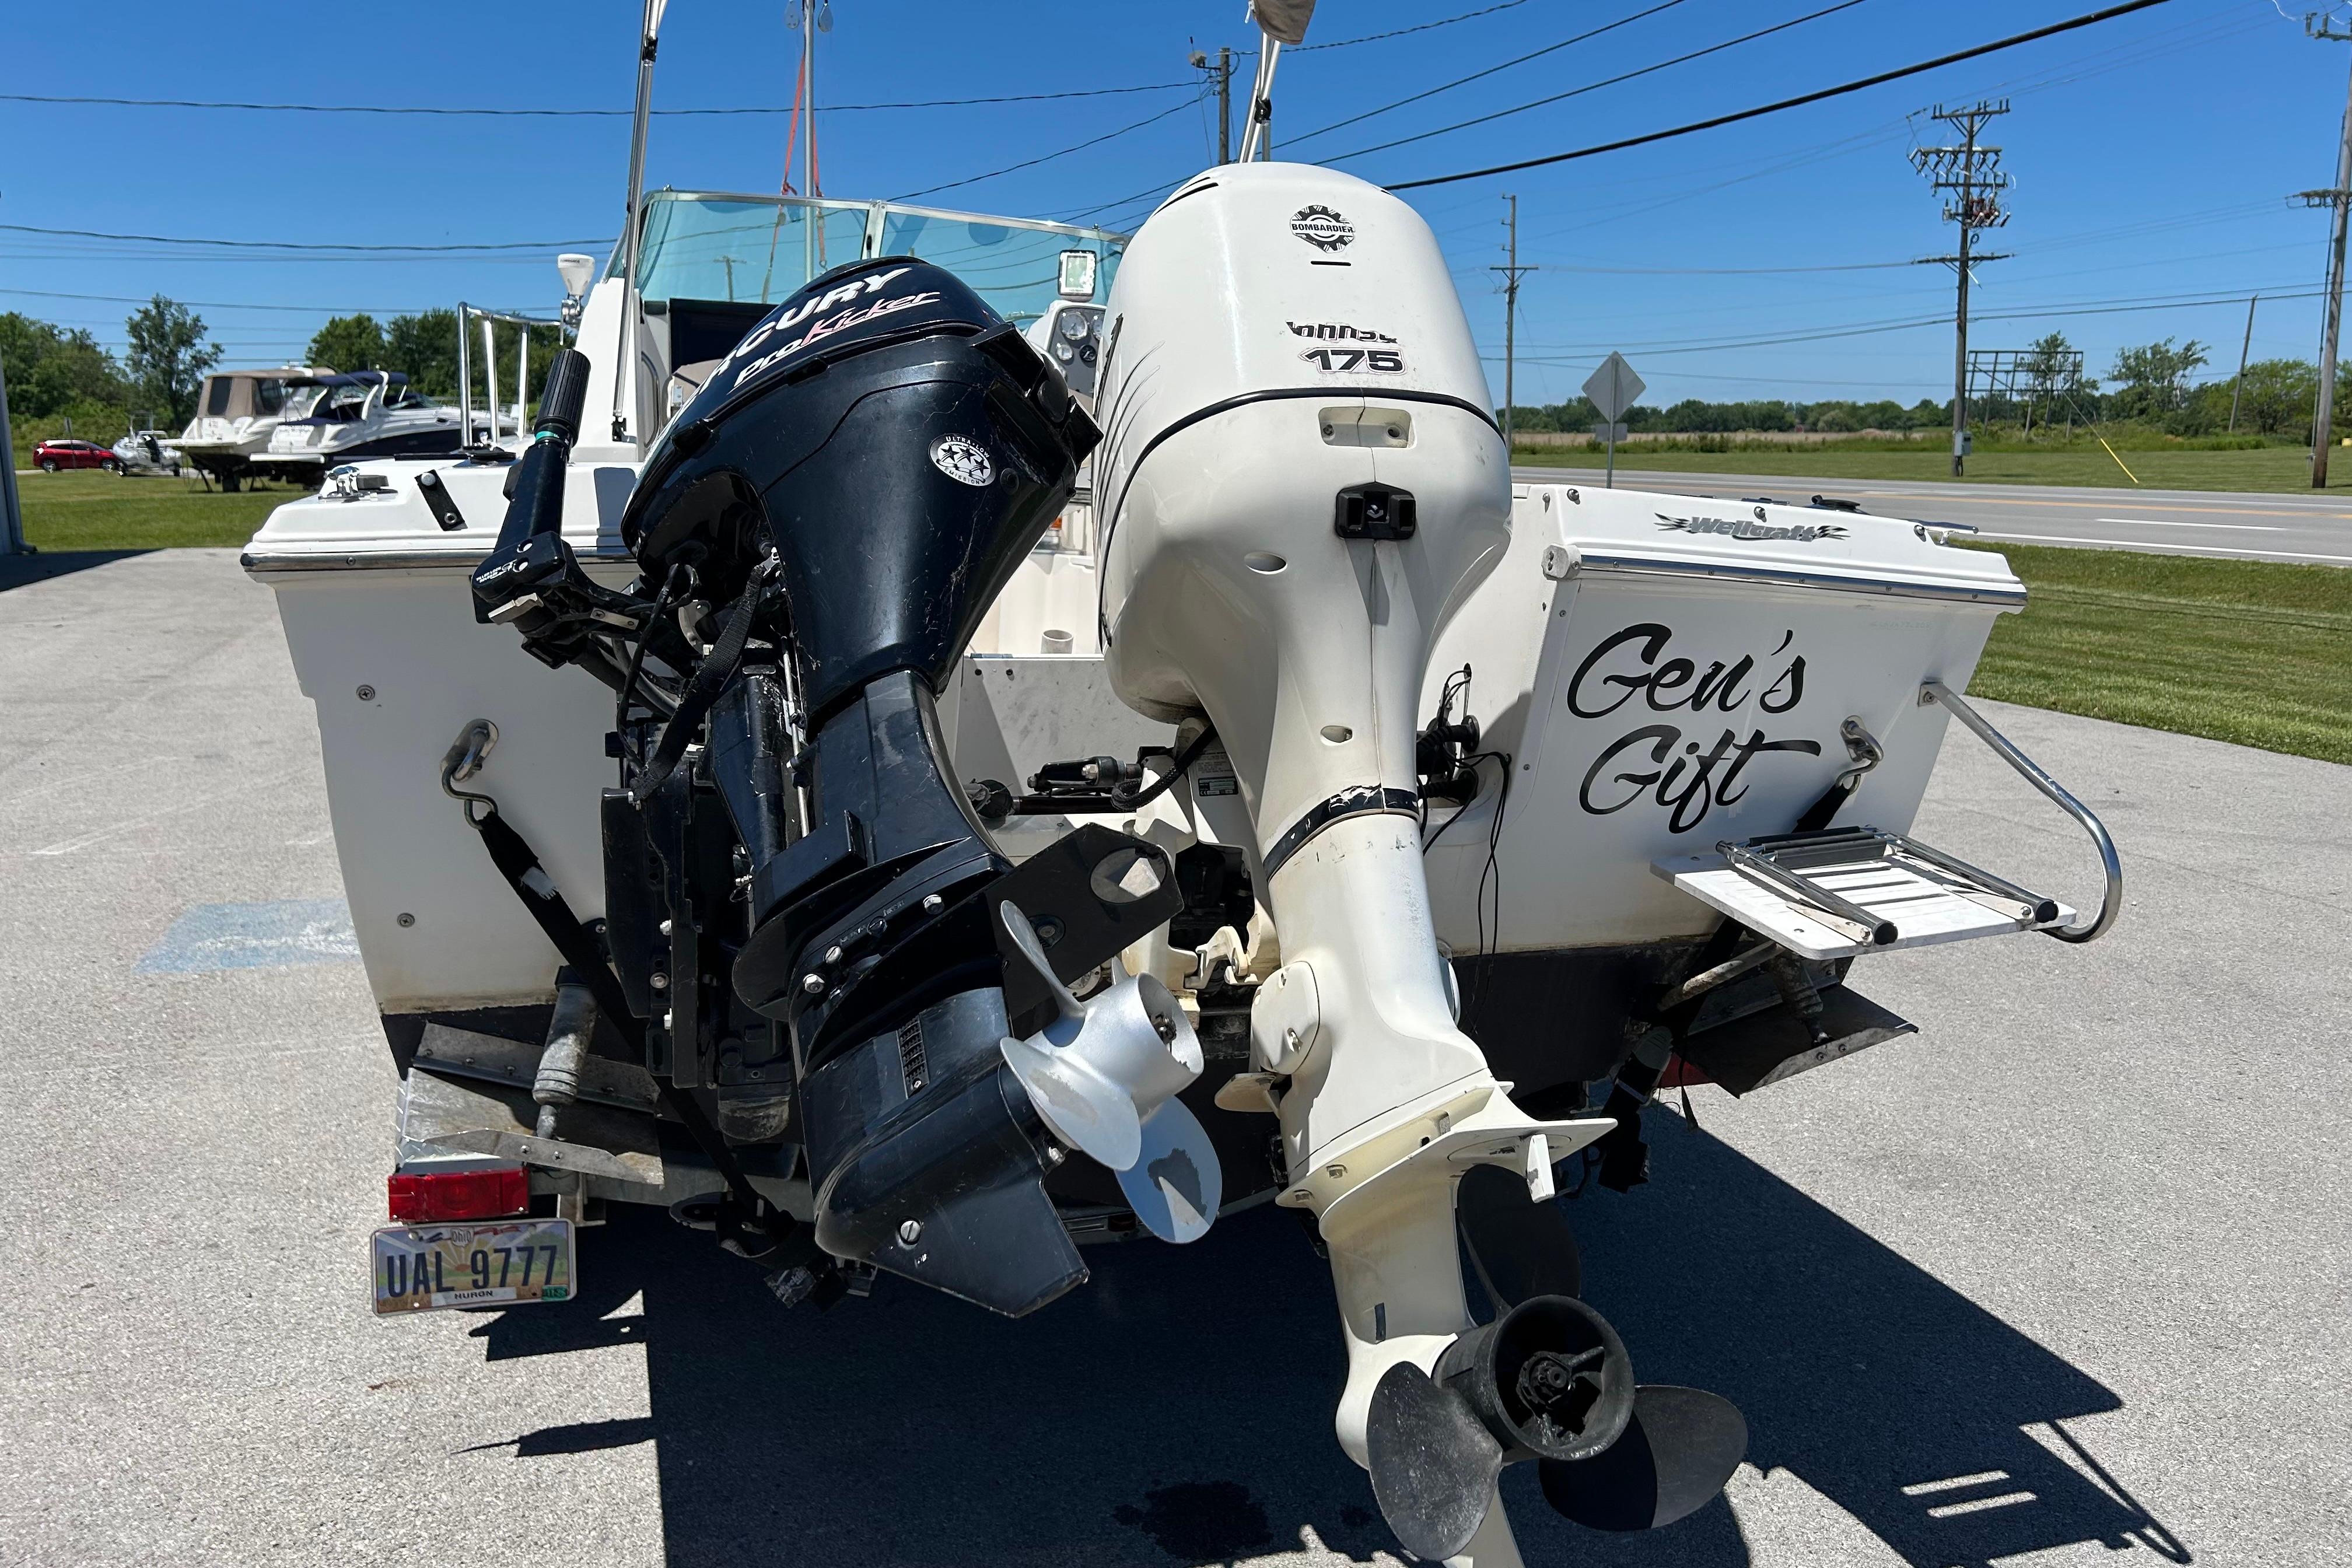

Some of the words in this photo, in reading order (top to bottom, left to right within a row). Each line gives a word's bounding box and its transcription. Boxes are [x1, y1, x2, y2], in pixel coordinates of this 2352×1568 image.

[1291, 223, 1354, 233] BOMBARDIER
[1304, 349, 1404, 372] 175
[944, 467, 981, 485] EMISSION
[1690, 516, 1816, 542] Wellcraft
[1566, 623, 1807, 719] Gen's
[1578, 724, 1821, 834] Gift
[386, 1251, 455, 1298] UAL
[470, 1244, 557, 1289] 9777
